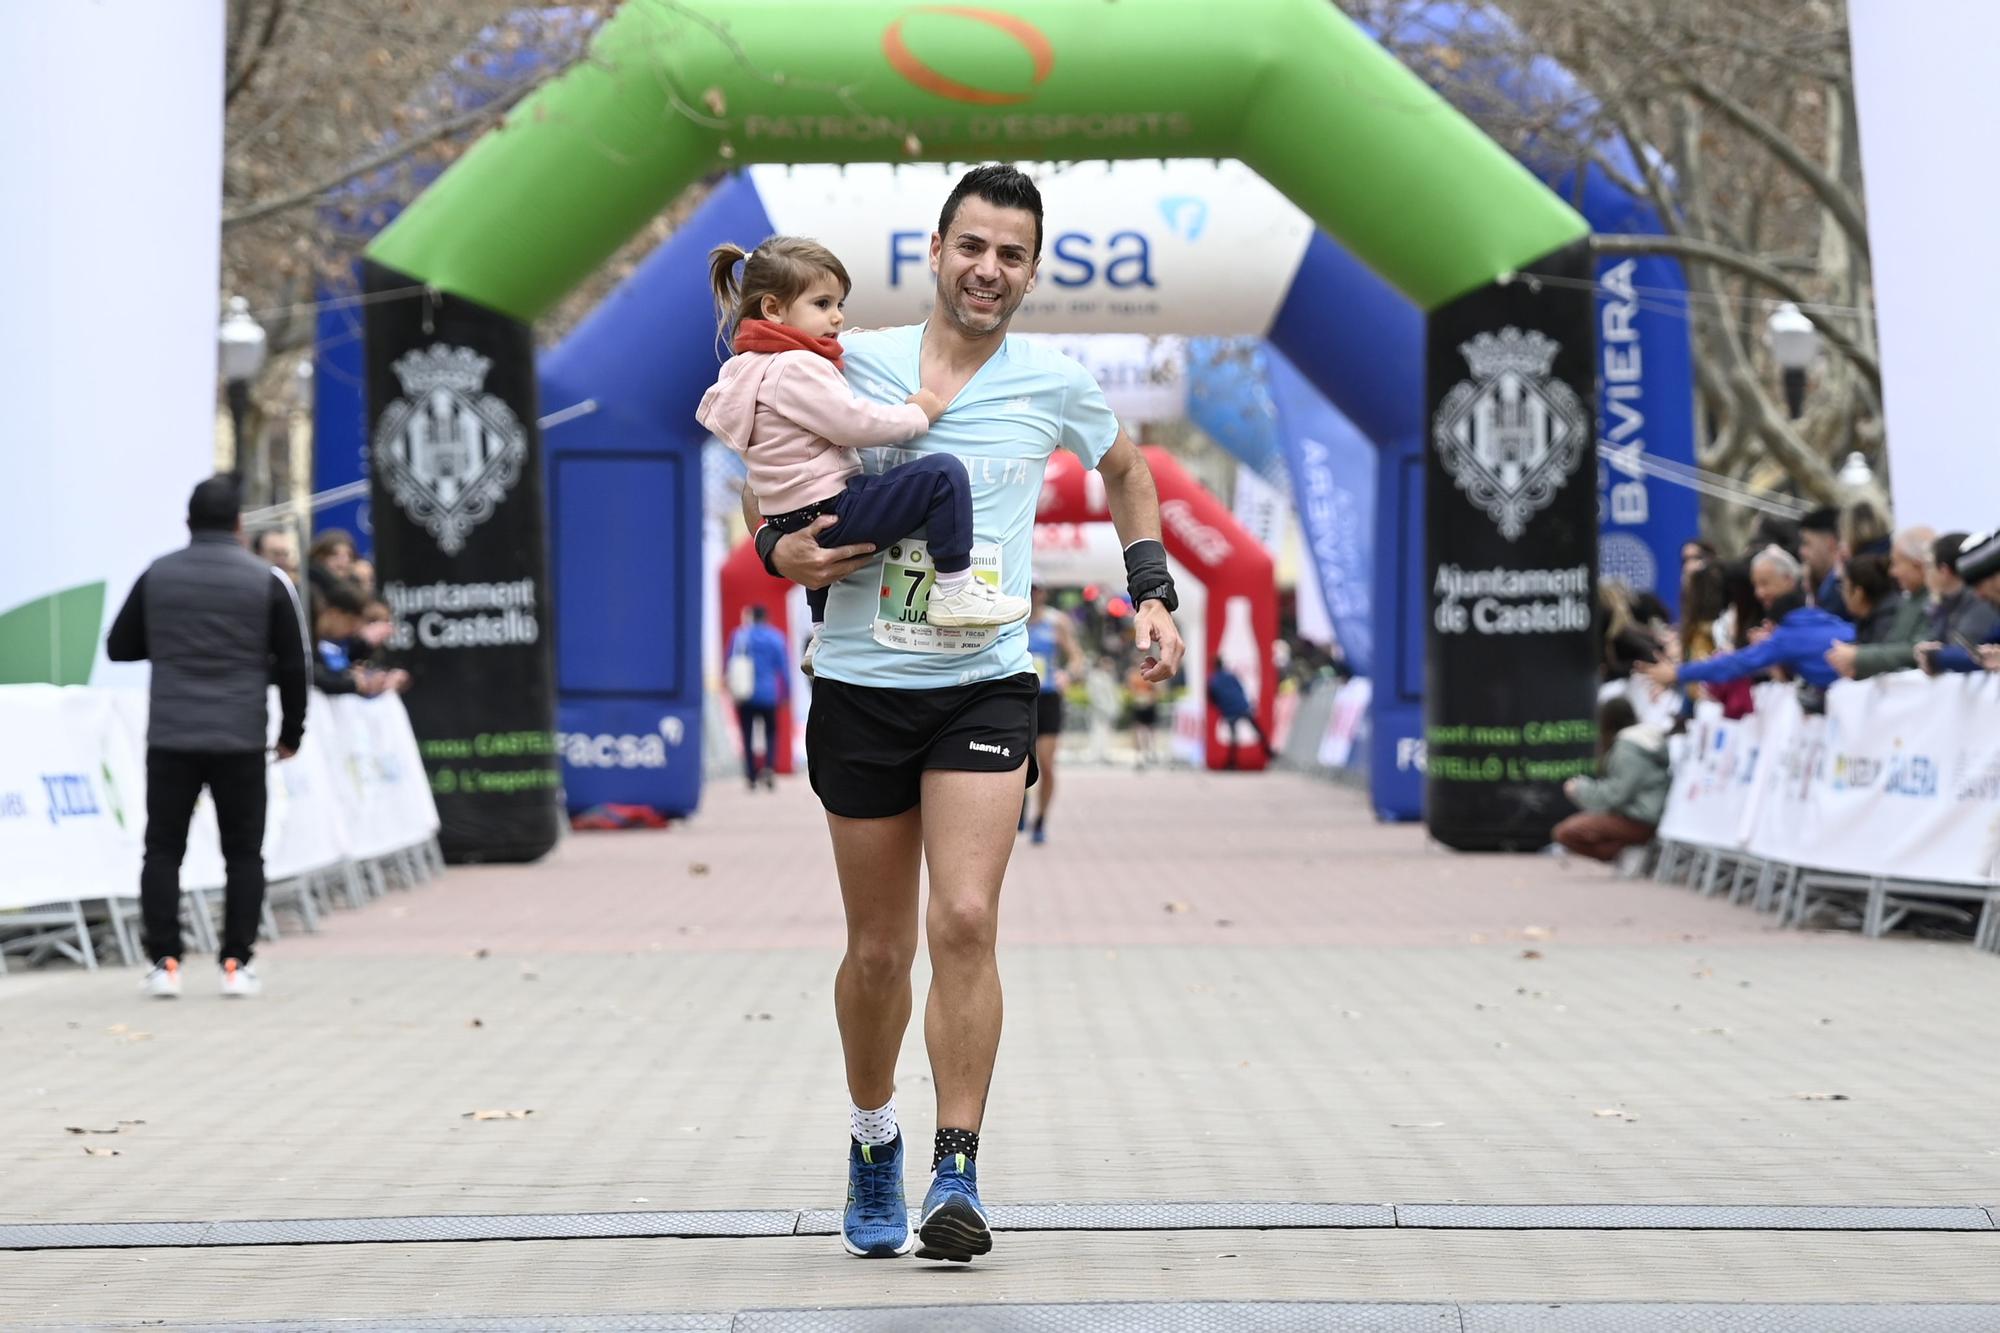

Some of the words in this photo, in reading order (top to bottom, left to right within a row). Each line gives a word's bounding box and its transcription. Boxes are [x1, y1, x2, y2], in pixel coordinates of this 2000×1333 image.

[889, 230, 1157, 288] Fsa
[1601, 257, 1648, 525] BAVIERA
[969, 555, 997, 566] ASTELLÓ
[1434, 564, 1589, 600] Ajuntament
[418, 607, 539, 649] Castelló
[898, 609, 928, 623] JUA
[1434, 599, 1468, 634] de
[1472, 594, 1591, 635] Castelló
